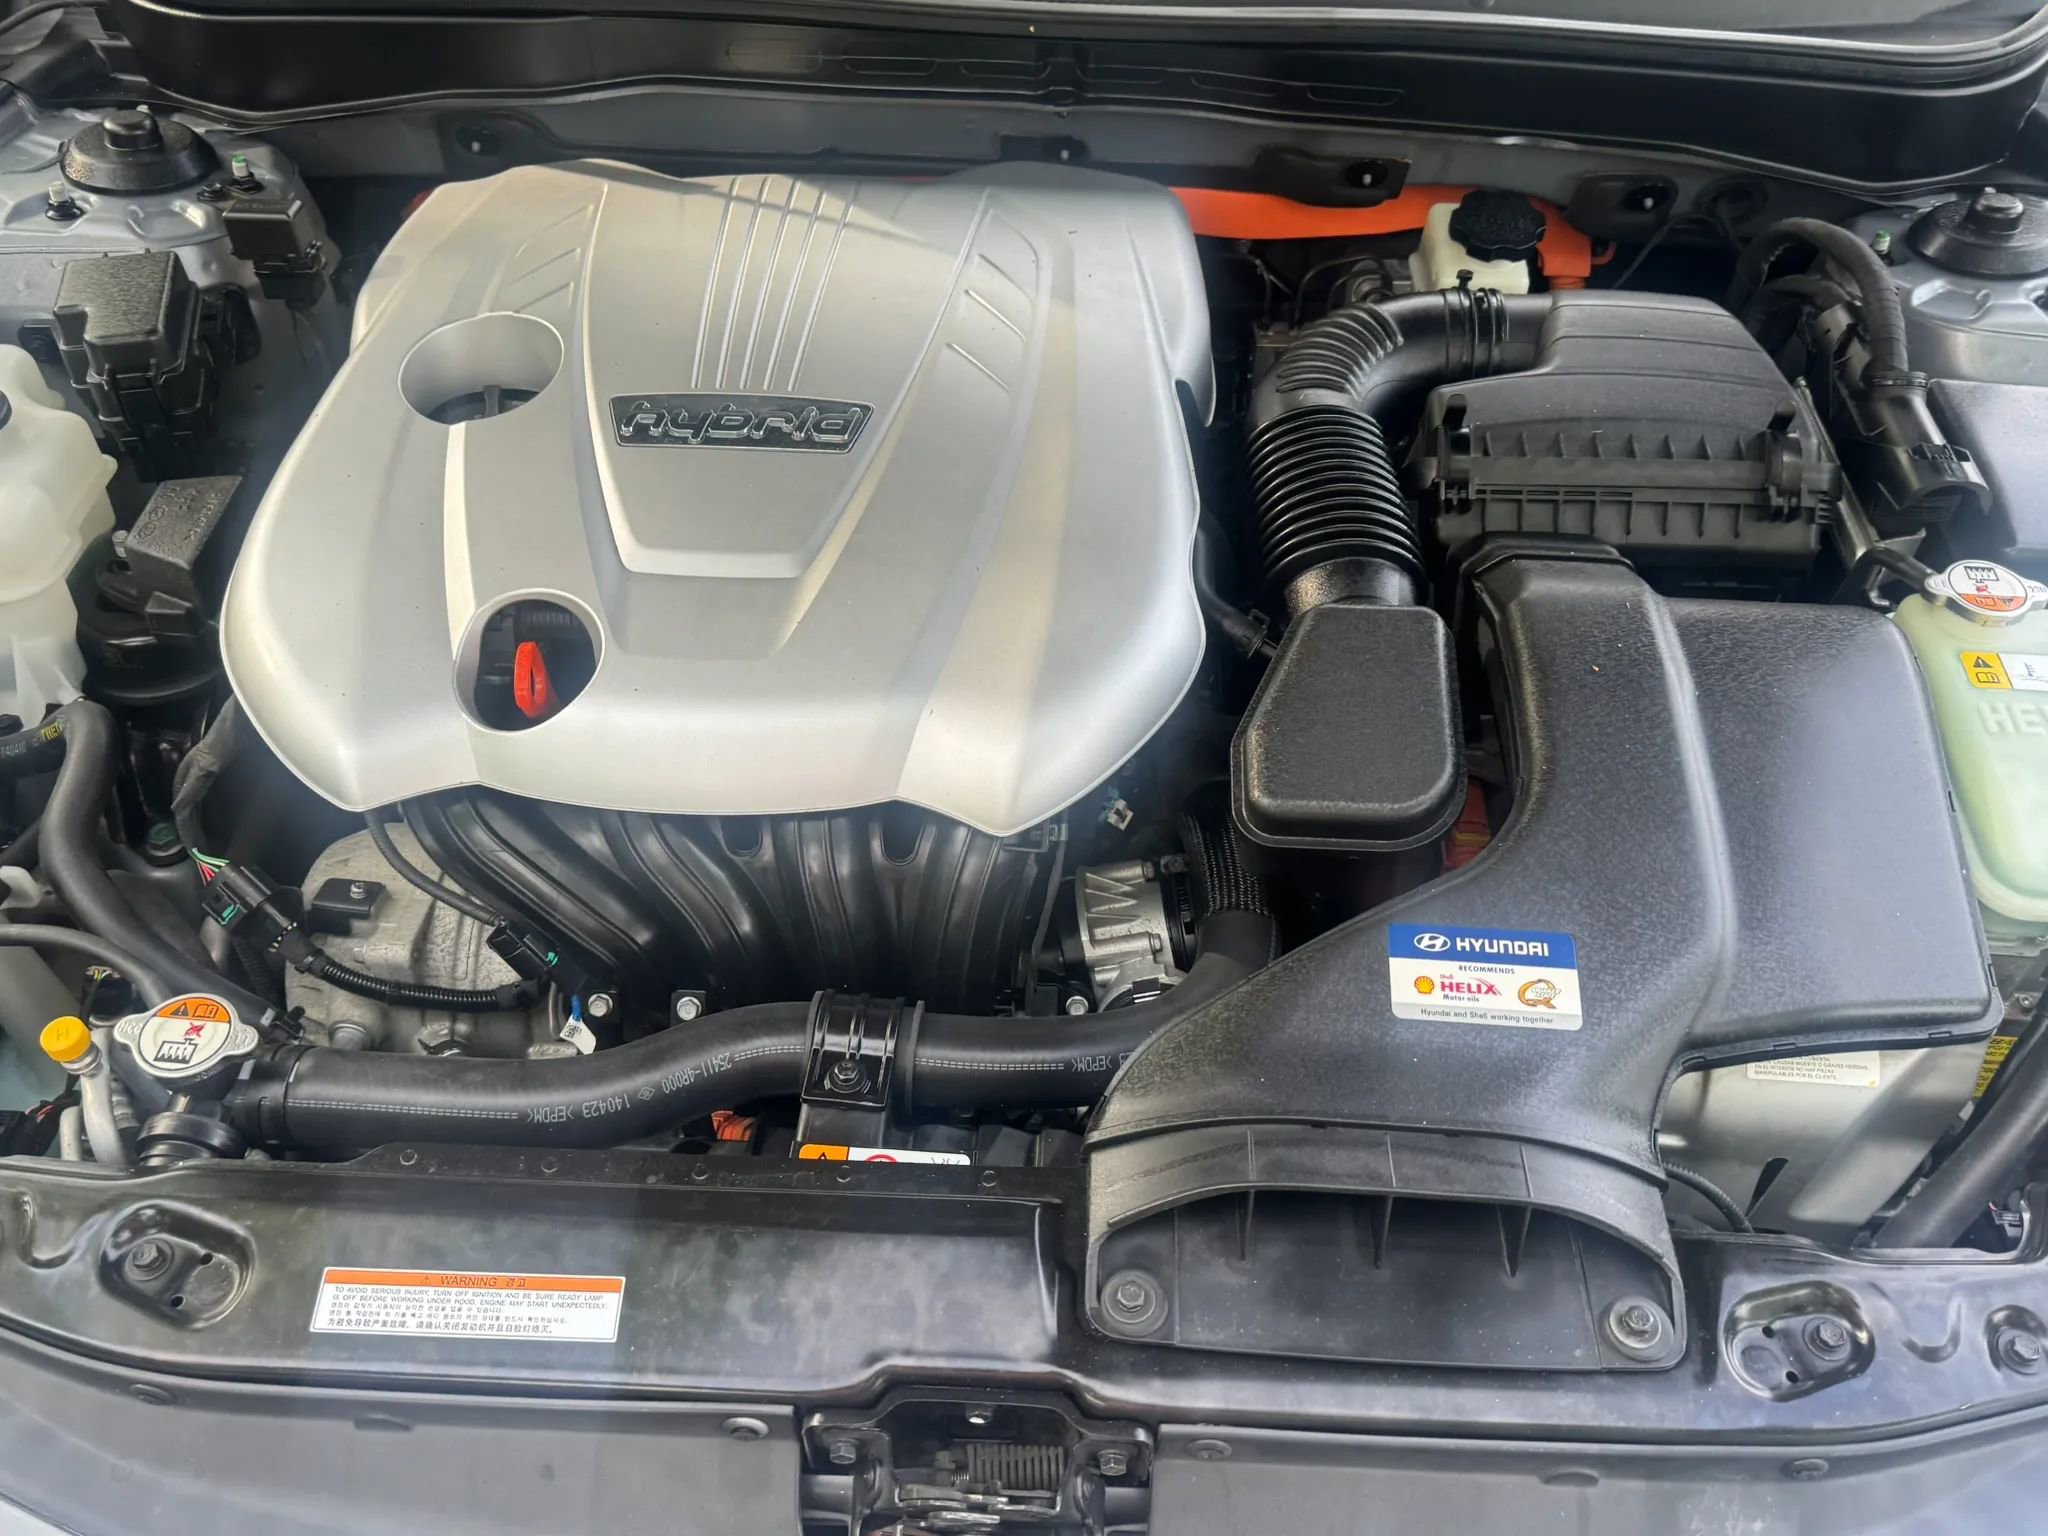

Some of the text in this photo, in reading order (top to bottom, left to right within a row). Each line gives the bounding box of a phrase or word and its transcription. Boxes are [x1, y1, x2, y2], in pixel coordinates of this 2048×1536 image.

[1977, 702, 2048, 735] HE
[1455, 937, 1549, 957] HYUNDAI
[1458, 965, 1515, 975] RECOMMENDS
[1440, 980, 1499, 996] HELIX
[1442, 994, 1480, 1003] Motor oils
[1420, 1008, 1553, 1025] Hyundai and Shell working together
[661, 1051, 732, 1094] 25411-4R000
[582, 1093, 630, 1118] 140423
[441, 1275, 497, 1287] WARNING
[371, 1287, 401, 1295] SERIOUS
[527, 1300, 549, 1308] START
